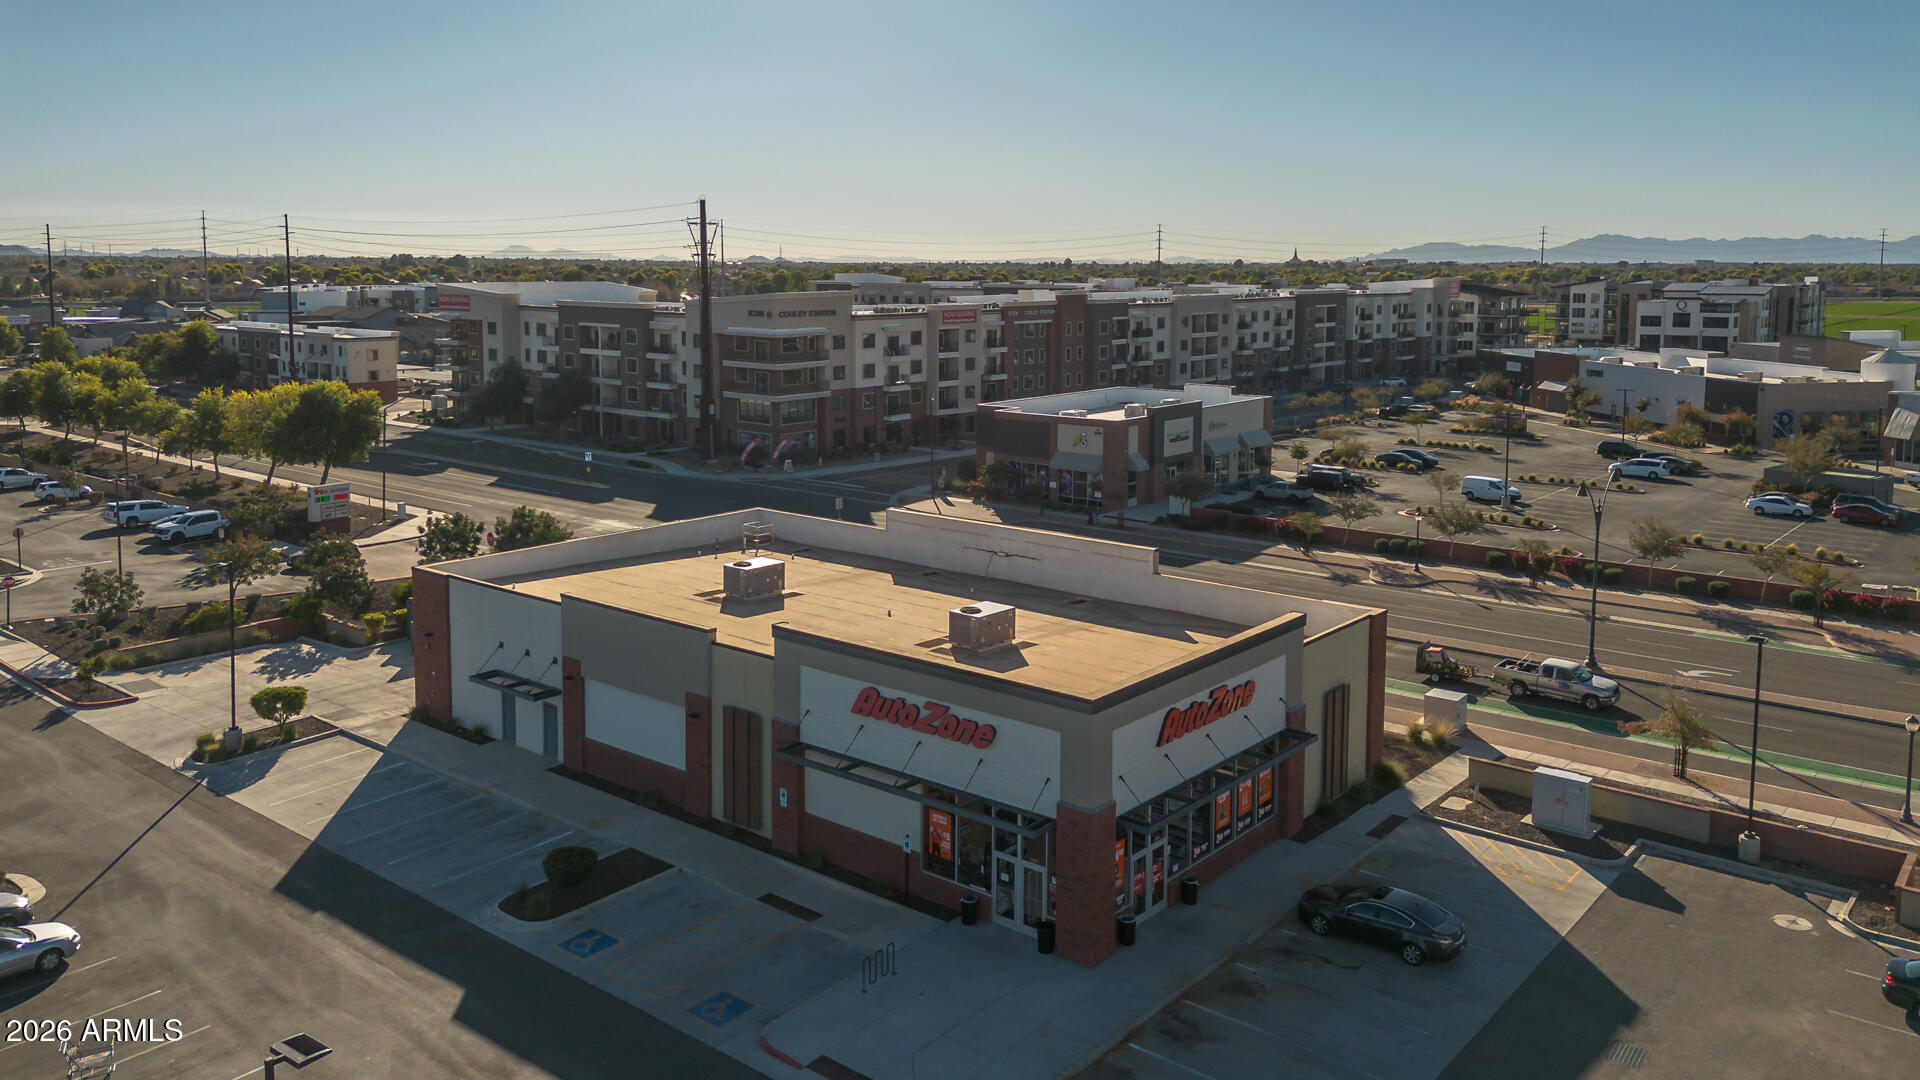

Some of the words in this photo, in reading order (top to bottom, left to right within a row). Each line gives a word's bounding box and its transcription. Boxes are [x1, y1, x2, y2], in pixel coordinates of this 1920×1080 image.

[779, 310, 807, 319] COOLEY
[808, 309, 837, 318] STATION
[850, 686, 997, 749] AutoZone
[1156, 680, 1256, 748] AutoZone
